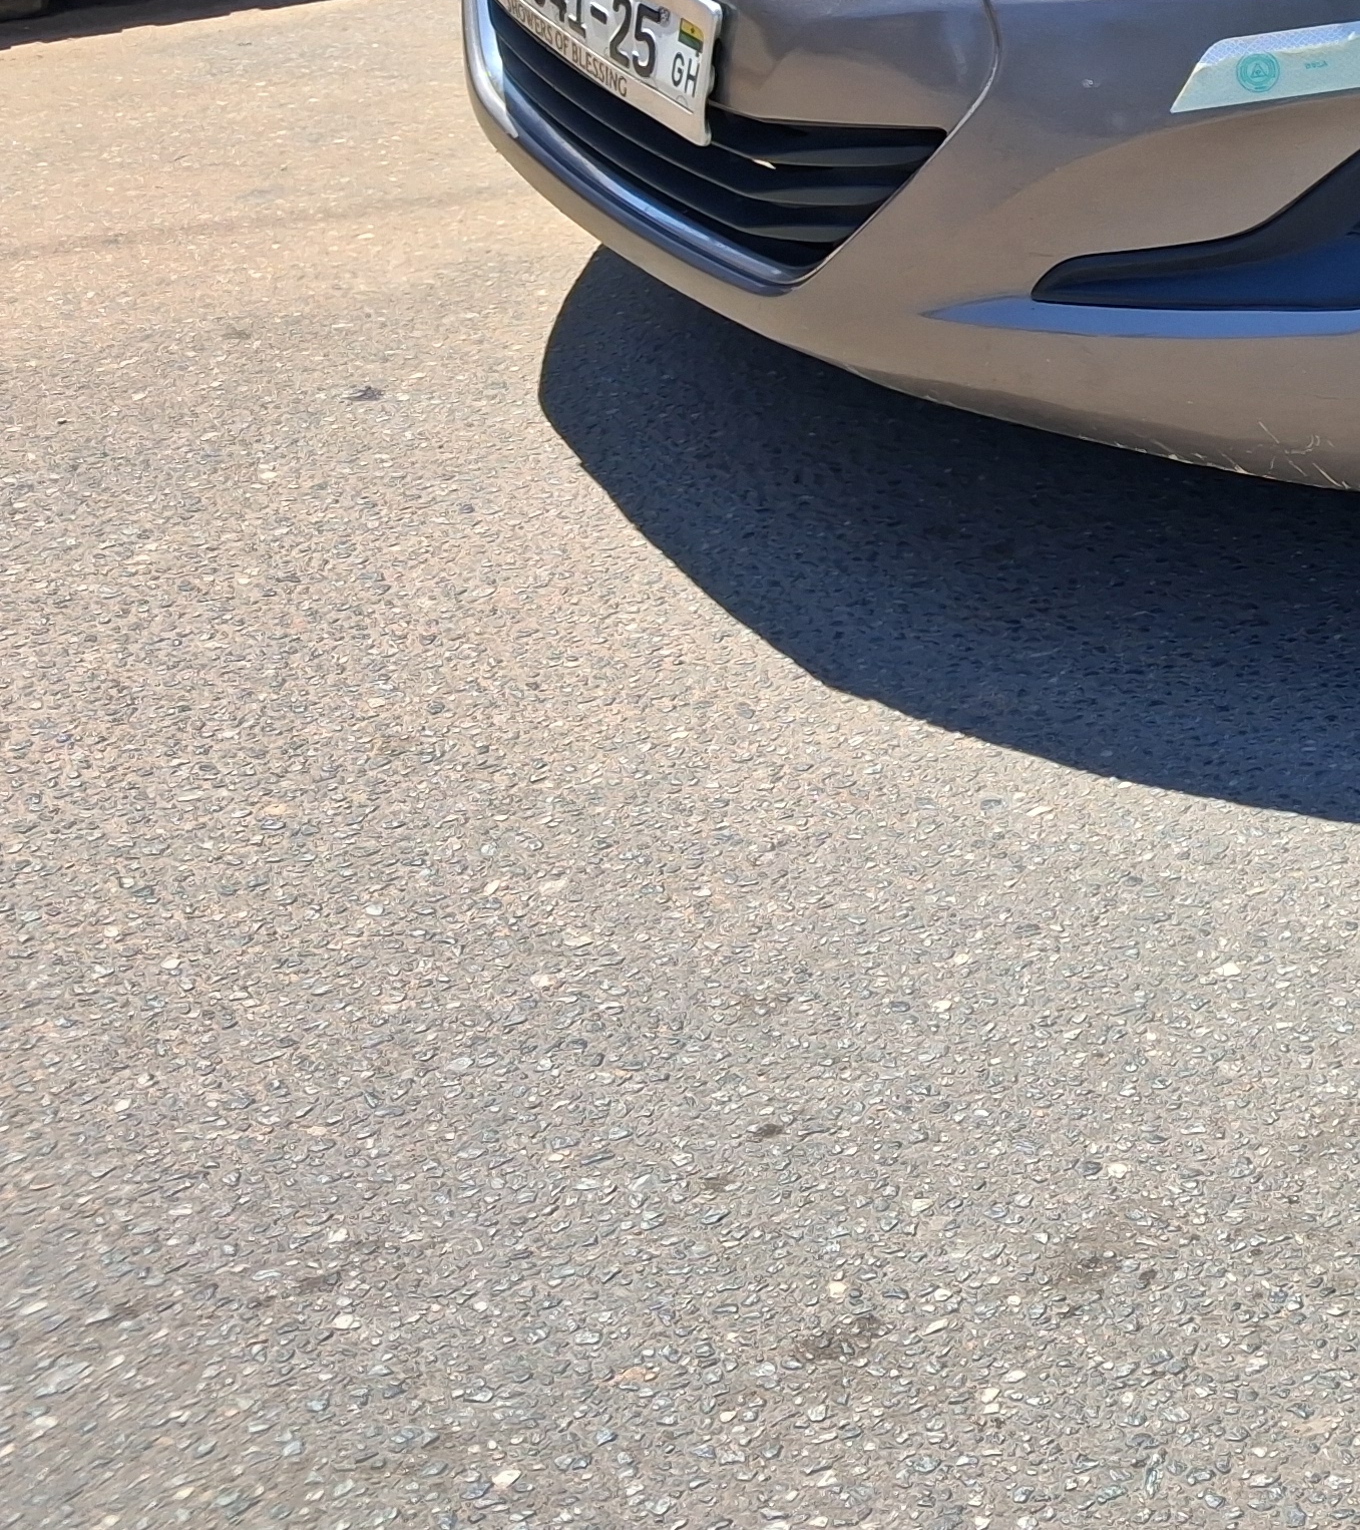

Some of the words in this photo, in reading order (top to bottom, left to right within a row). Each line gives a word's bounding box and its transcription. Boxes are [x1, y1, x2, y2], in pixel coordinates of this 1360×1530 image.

[554, 33, 570, 54] OF
[571, 41, 628, 98] BLESSING
[671, 52, 700, 99] GH
